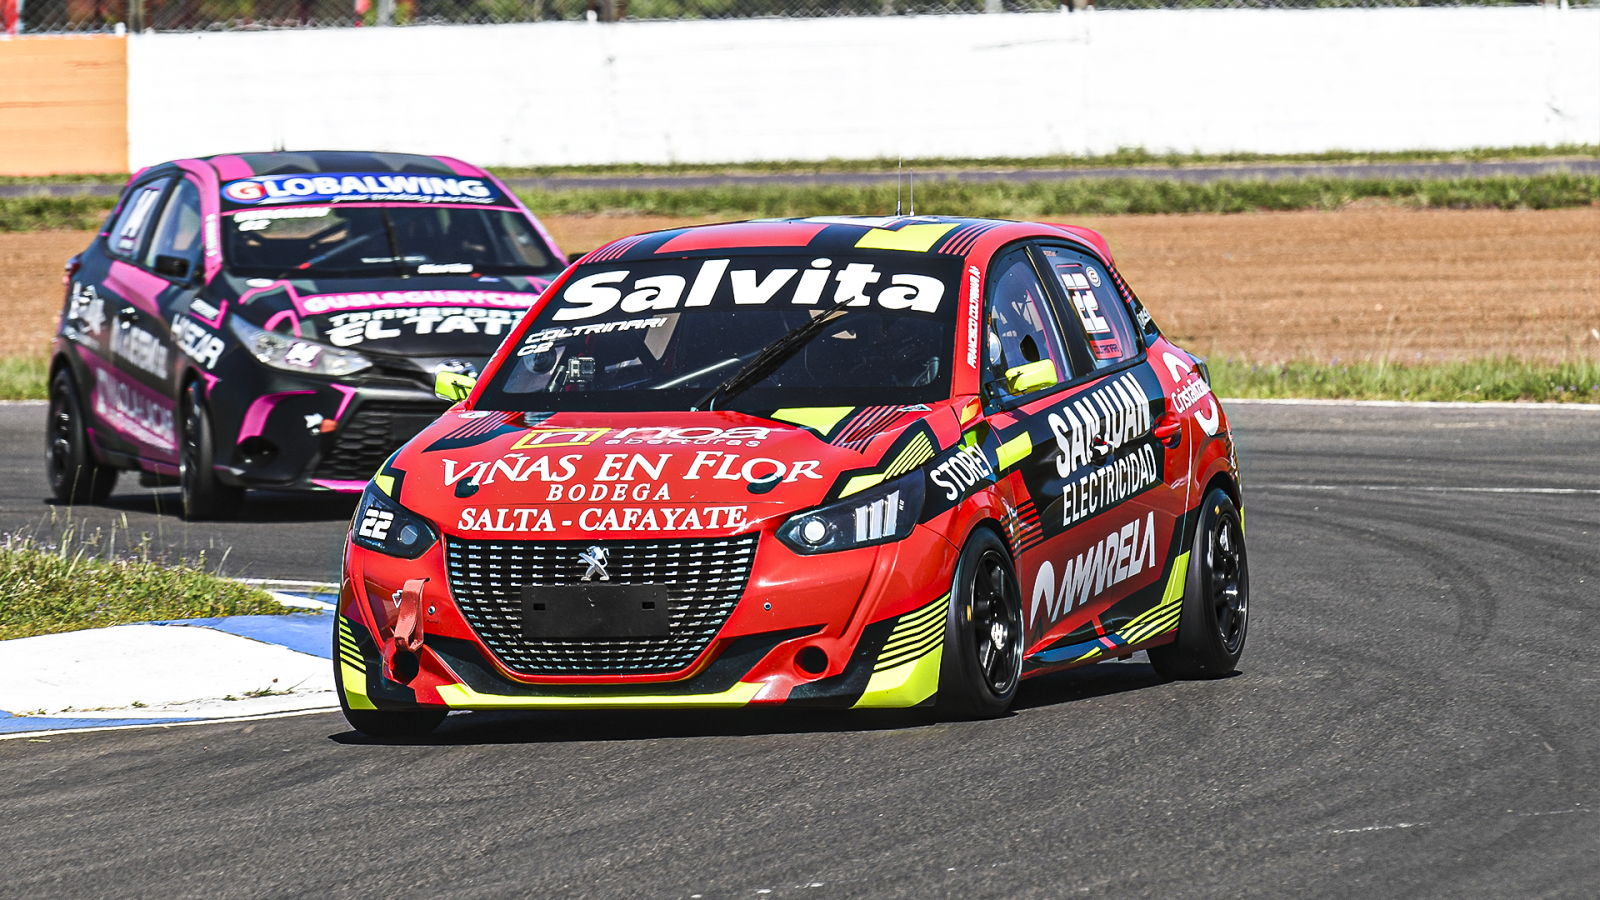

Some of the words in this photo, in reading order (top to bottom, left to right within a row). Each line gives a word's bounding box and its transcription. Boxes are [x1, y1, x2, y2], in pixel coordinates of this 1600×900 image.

[227, 176, 490, 199] GLOBALWING
[552, 258, 945, 321] Salvita
[325, 320, 401, 347] EL
[403, 314, 520, 336] TAT
[525, 317, 668, 344] COLTRINARI
[604, 437, 762, 448] aberturas
[613, 427, 771, 440] noa
[442, 452, 583, 487] VIÑAS
[594, 453, 674, 481] EN
[682, 451, 824, 484] FLOR
[929, 442, 994, 501] STOREY
[1062, 443, 1157, 527] ELECTRICIDAD
[545, 484, 671, 502] BODEGA
[359, 508, 394, 540] 22
[457, 507, 557, 532] SALTA
[578, 506, 748, 531] CAFAYATE
[1051, 511, 1156, 623] AMARELA
